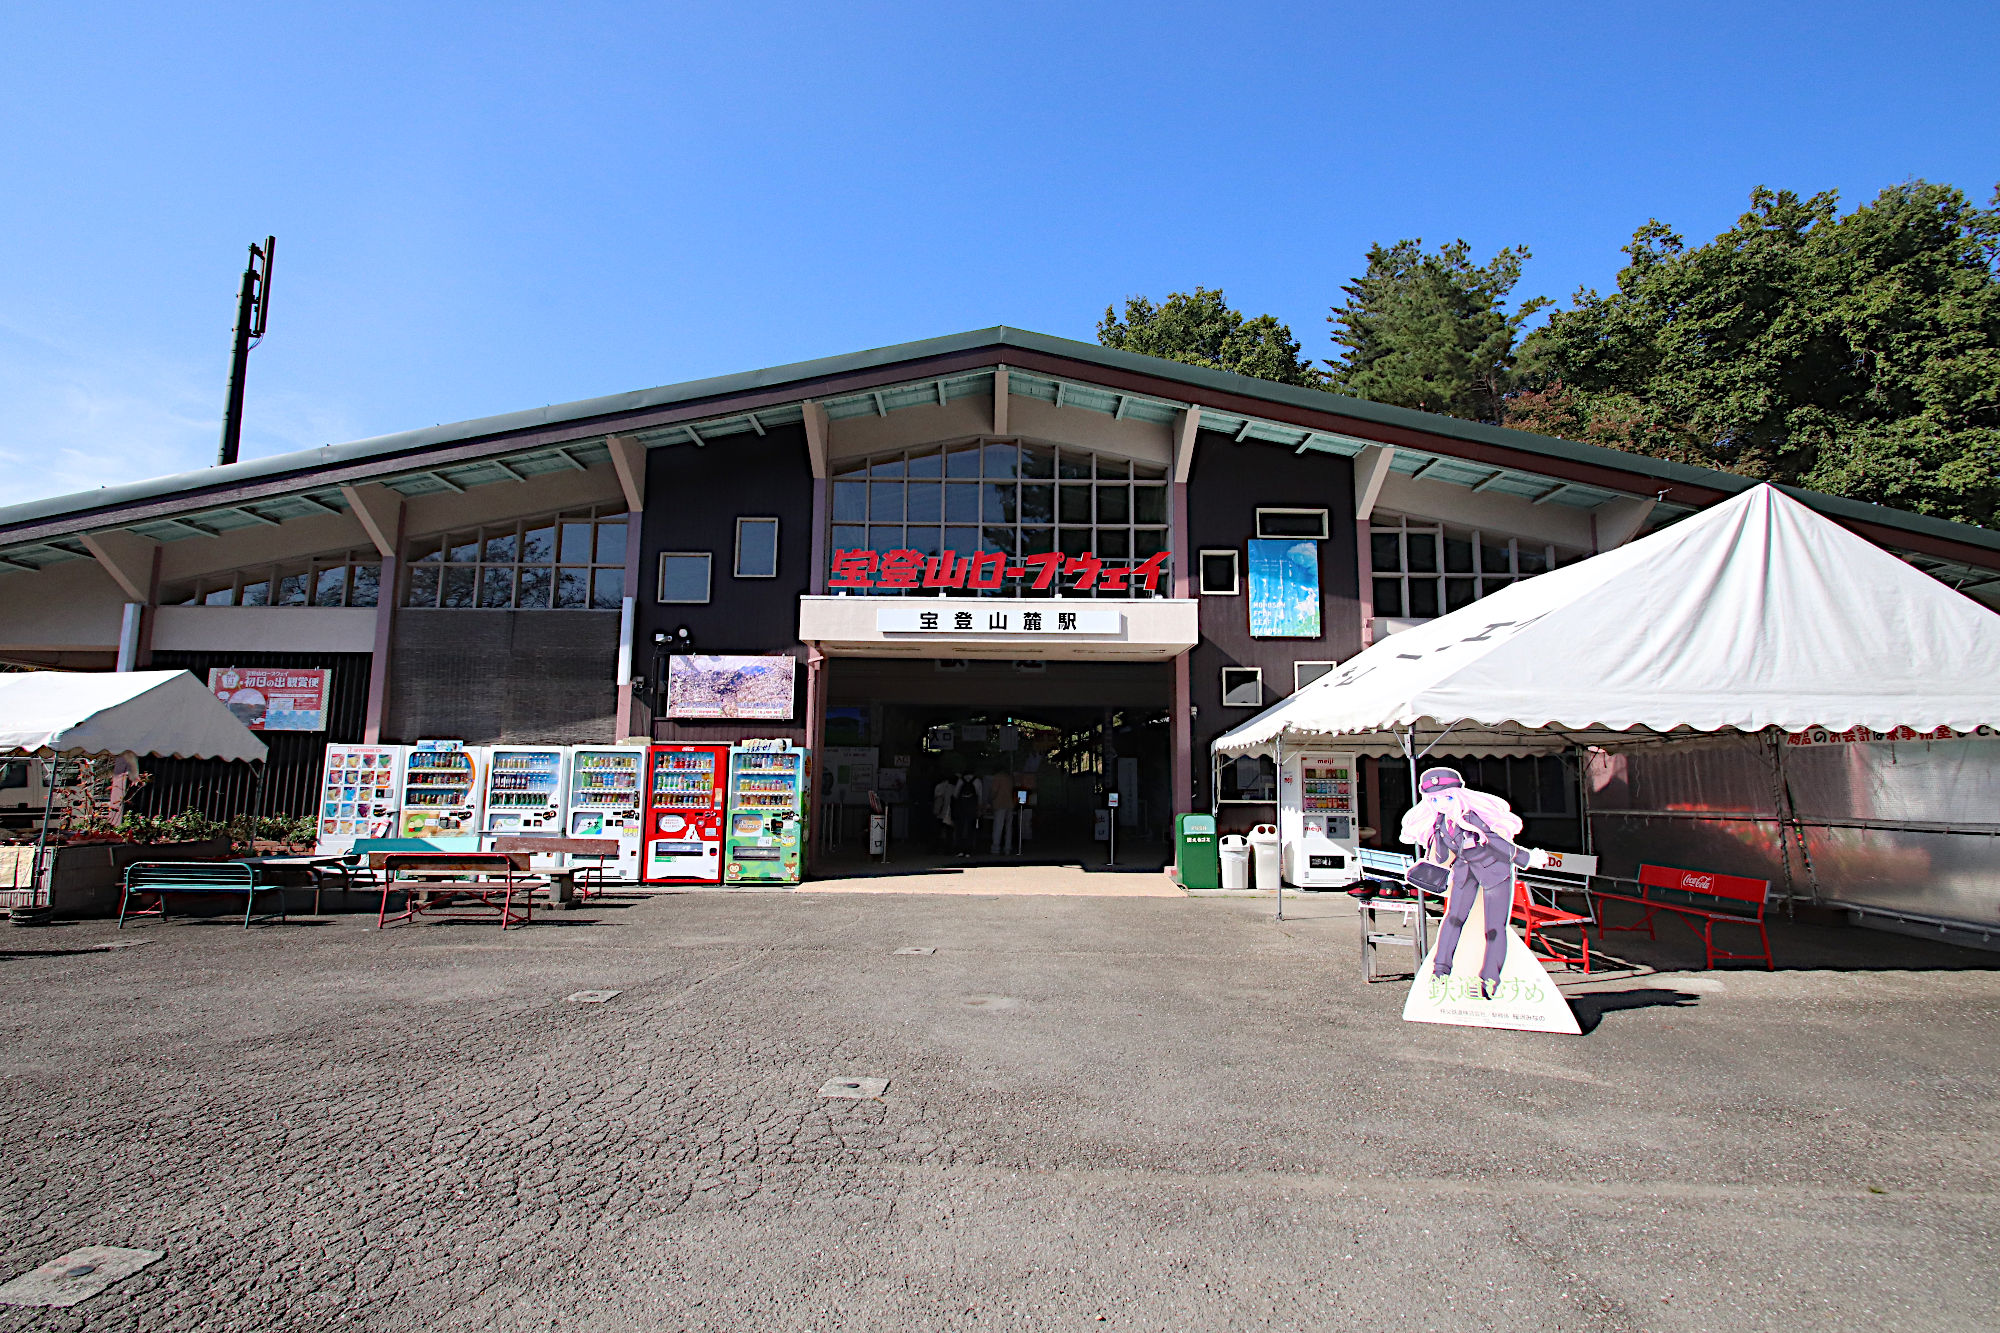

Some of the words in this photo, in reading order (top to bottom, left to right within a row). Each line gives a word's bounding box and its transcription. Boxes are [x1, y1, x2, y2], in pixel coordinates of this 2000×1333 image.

[828, 548, 1171, 590] 宝登山ロープウェイ
[919, 611, 1077, 631] 宝登山麓駅
[1317, 757, 1334, 765] meiji
[1682, 873, 1713, 890] Coca-Cola
[1428, 974, 1545, 1007] 鉄道むすめ
